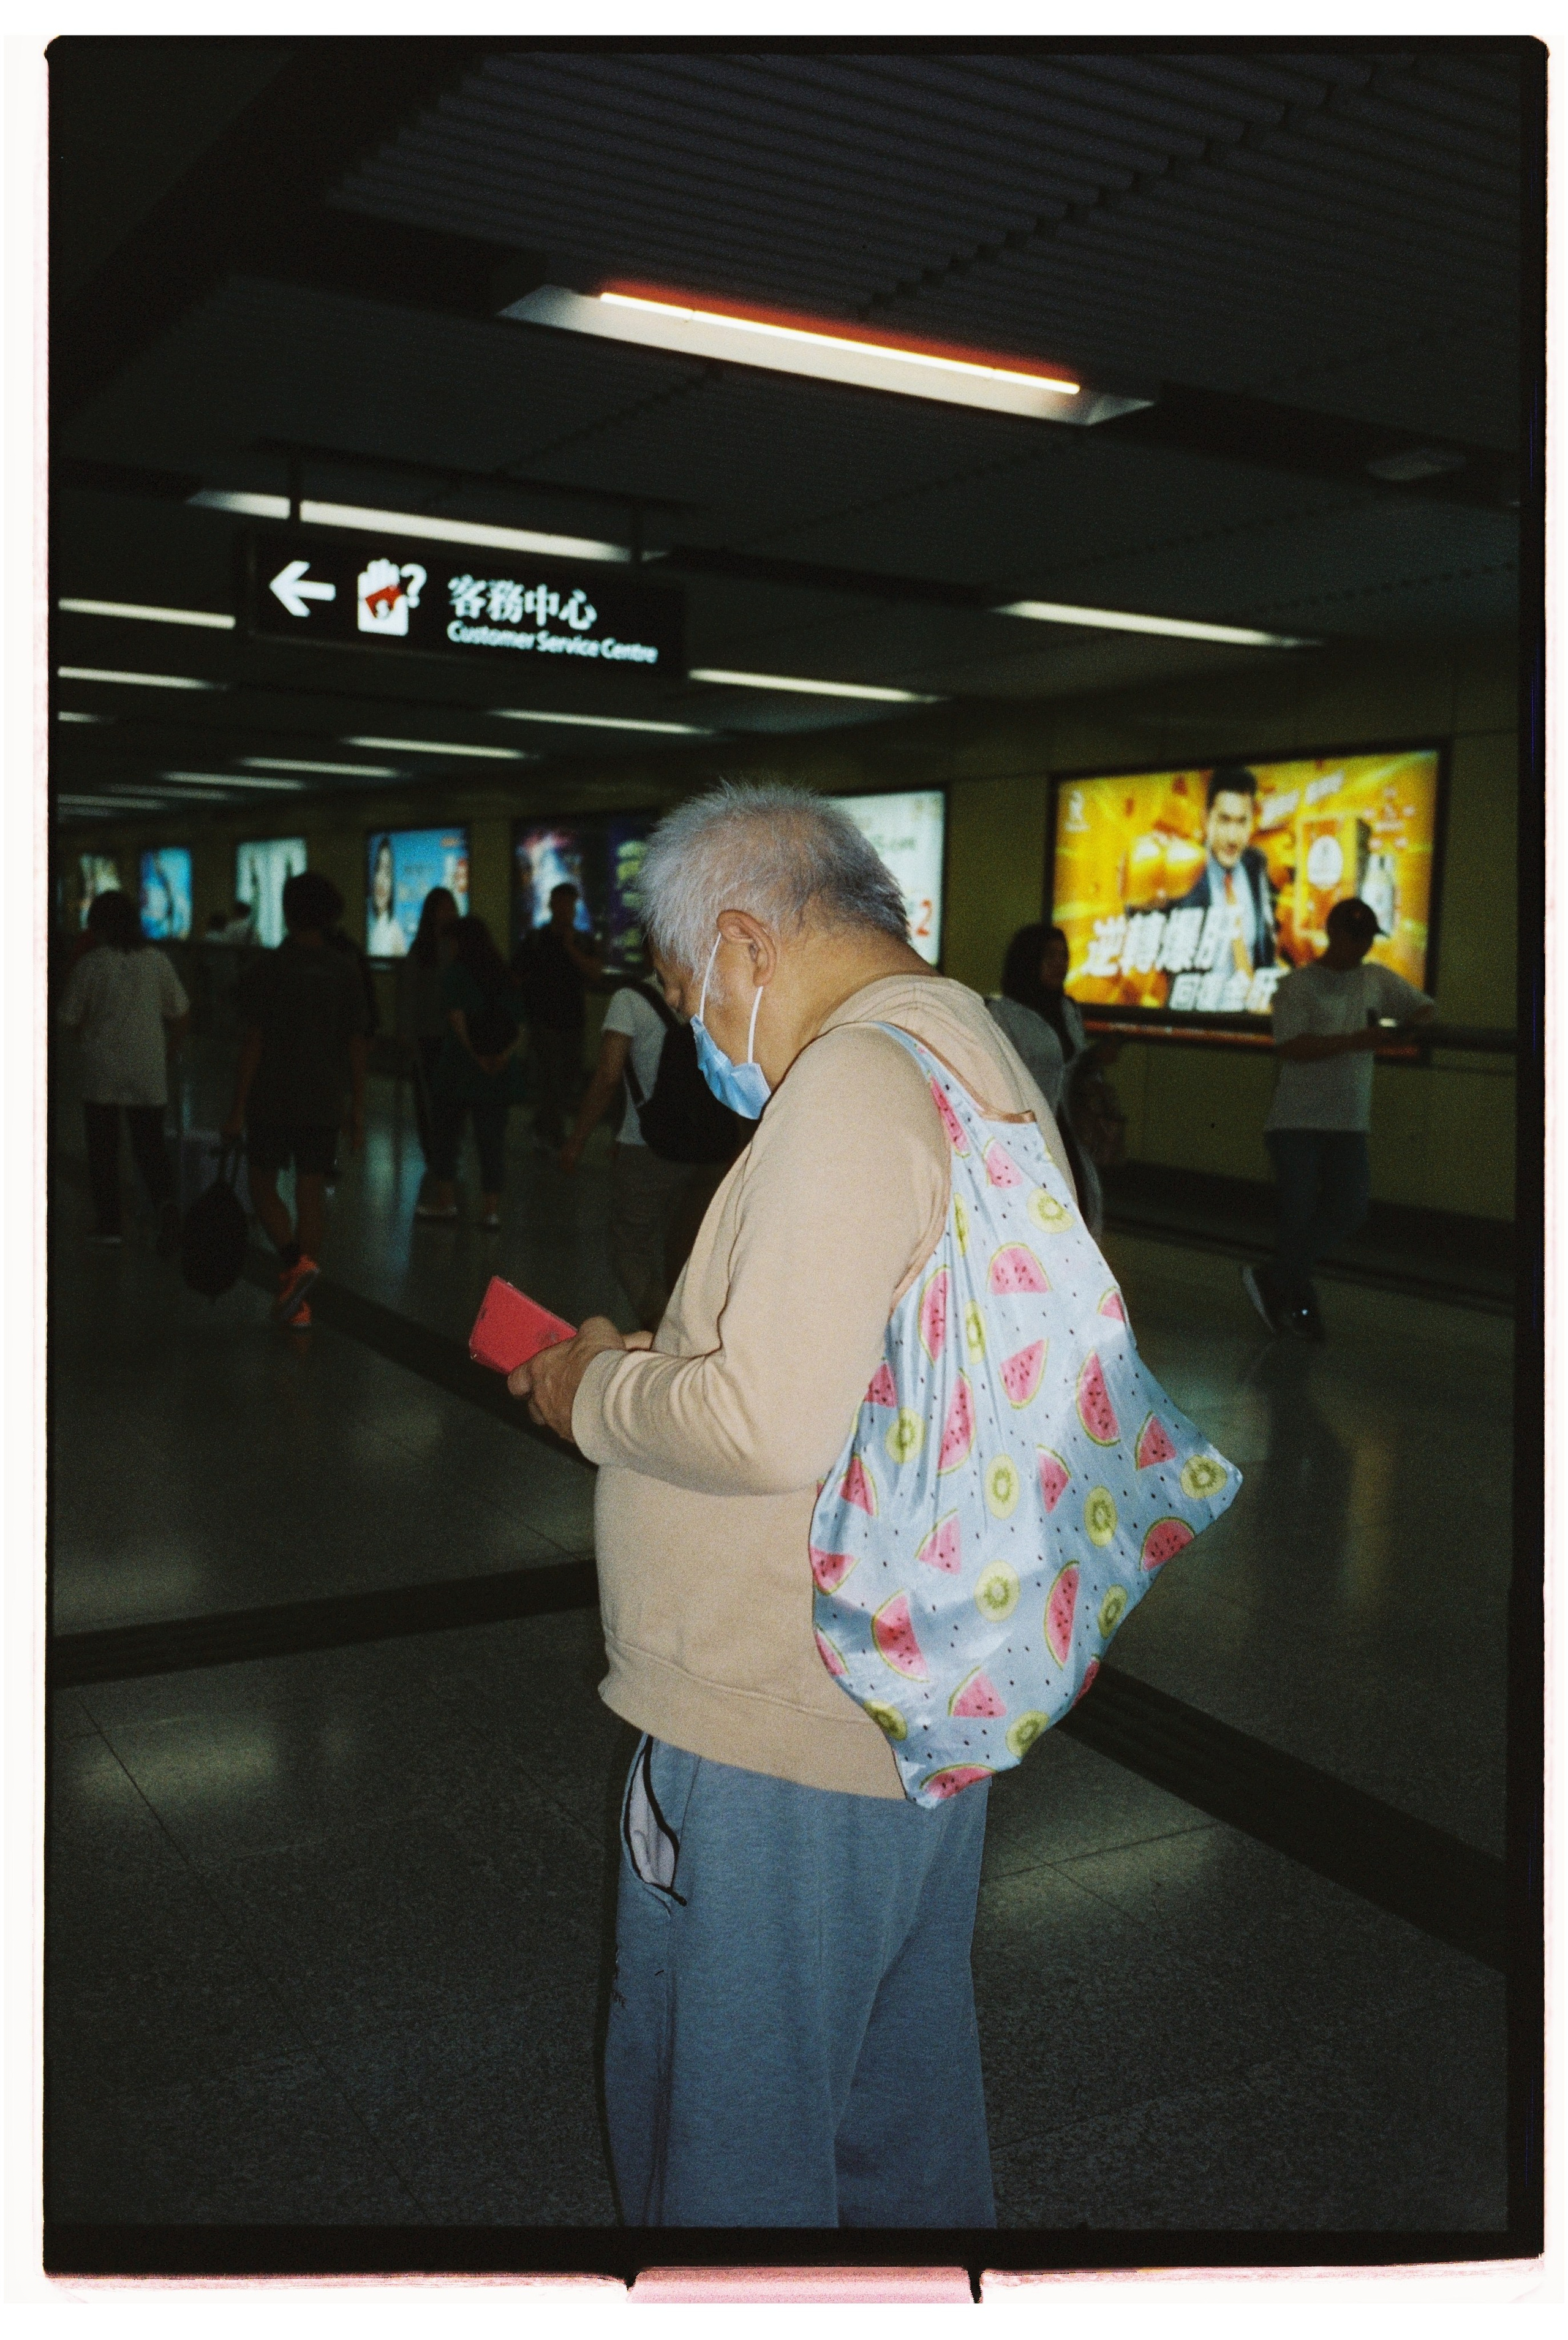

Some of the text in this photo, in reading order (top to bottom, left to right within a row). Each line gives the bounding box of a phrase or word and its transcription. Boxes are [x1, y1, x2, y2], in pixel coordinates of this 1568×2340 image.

[448, 574, 597, 630] 客務中心
[447, 619, 658, 664] Customer Service Centre
